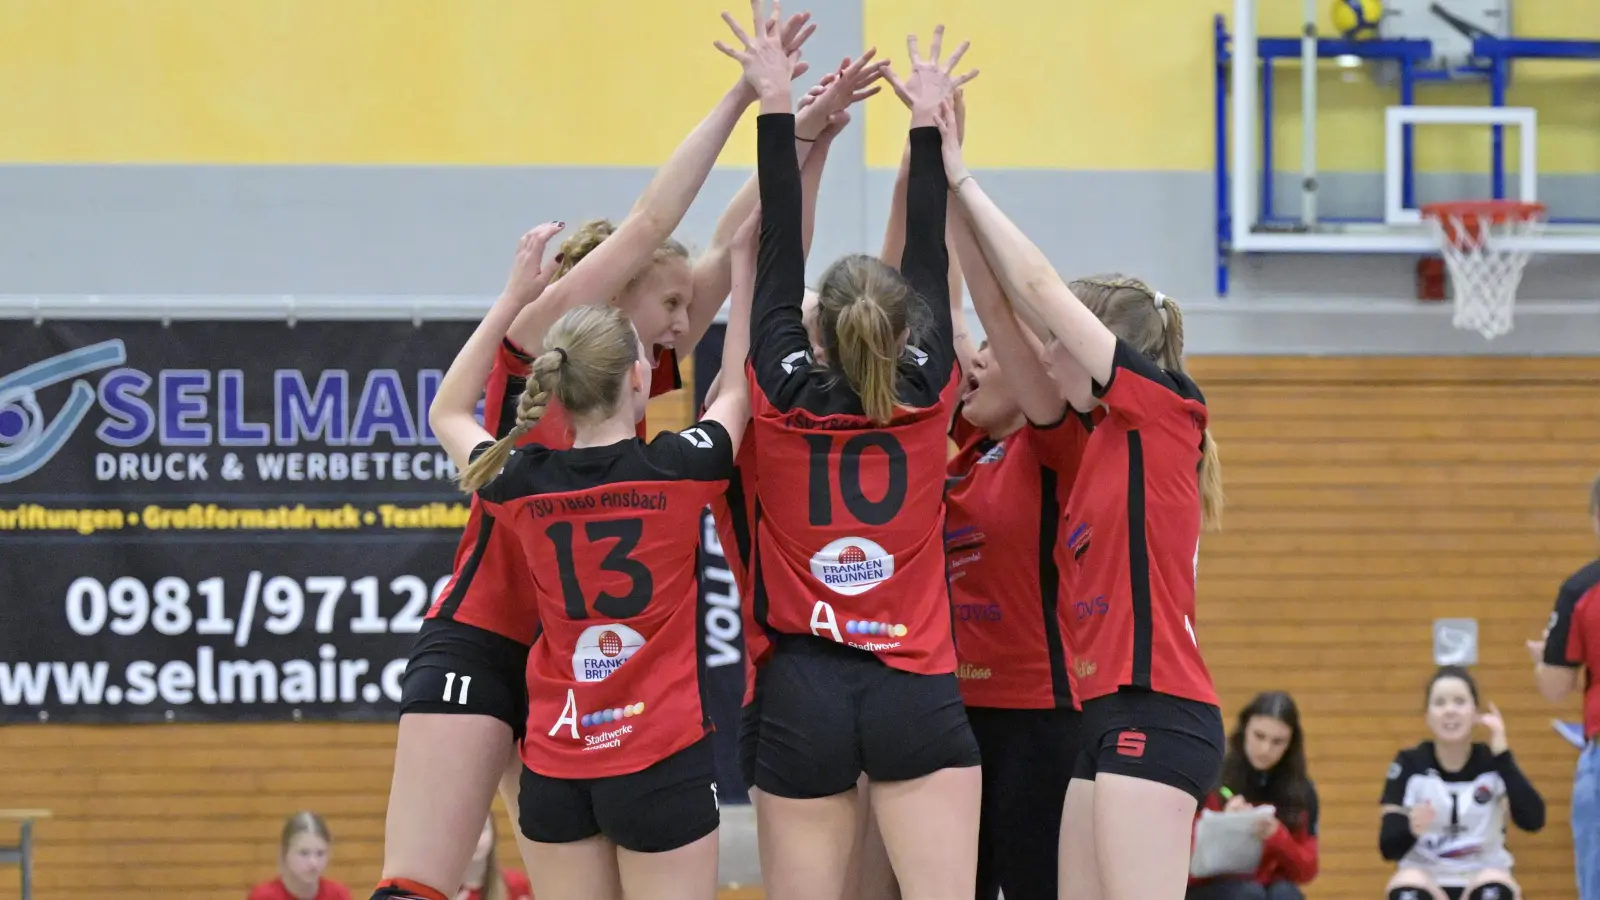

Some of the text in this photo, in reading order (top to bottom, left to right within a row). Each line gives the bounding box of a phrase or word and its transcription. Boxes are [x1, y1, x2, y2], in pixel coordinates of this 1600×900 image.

[96, 368, 485, 447] SELMAI
[96, 452, 209, 481] DRUCK
[220, 452, 244, 481] &
[802, 431, 907, 526] 10
[142, 503, 360, 530] Großformatdruck
[525, 489, 667, 519] TSV 1860 Ansbach
[544, 518, 655, 620] 13
[823, 559, 882, 574] FRANKEN
[824, 569, 884, 584] BRUNNEN
[584, 659, 628, 669] FRANK
[442, 672, 472, 705] 11
[548, 688, 580, 739] A
[585, 725, 633, 746] Stadtwerke
[1450, 793, 1458, 824] 1
